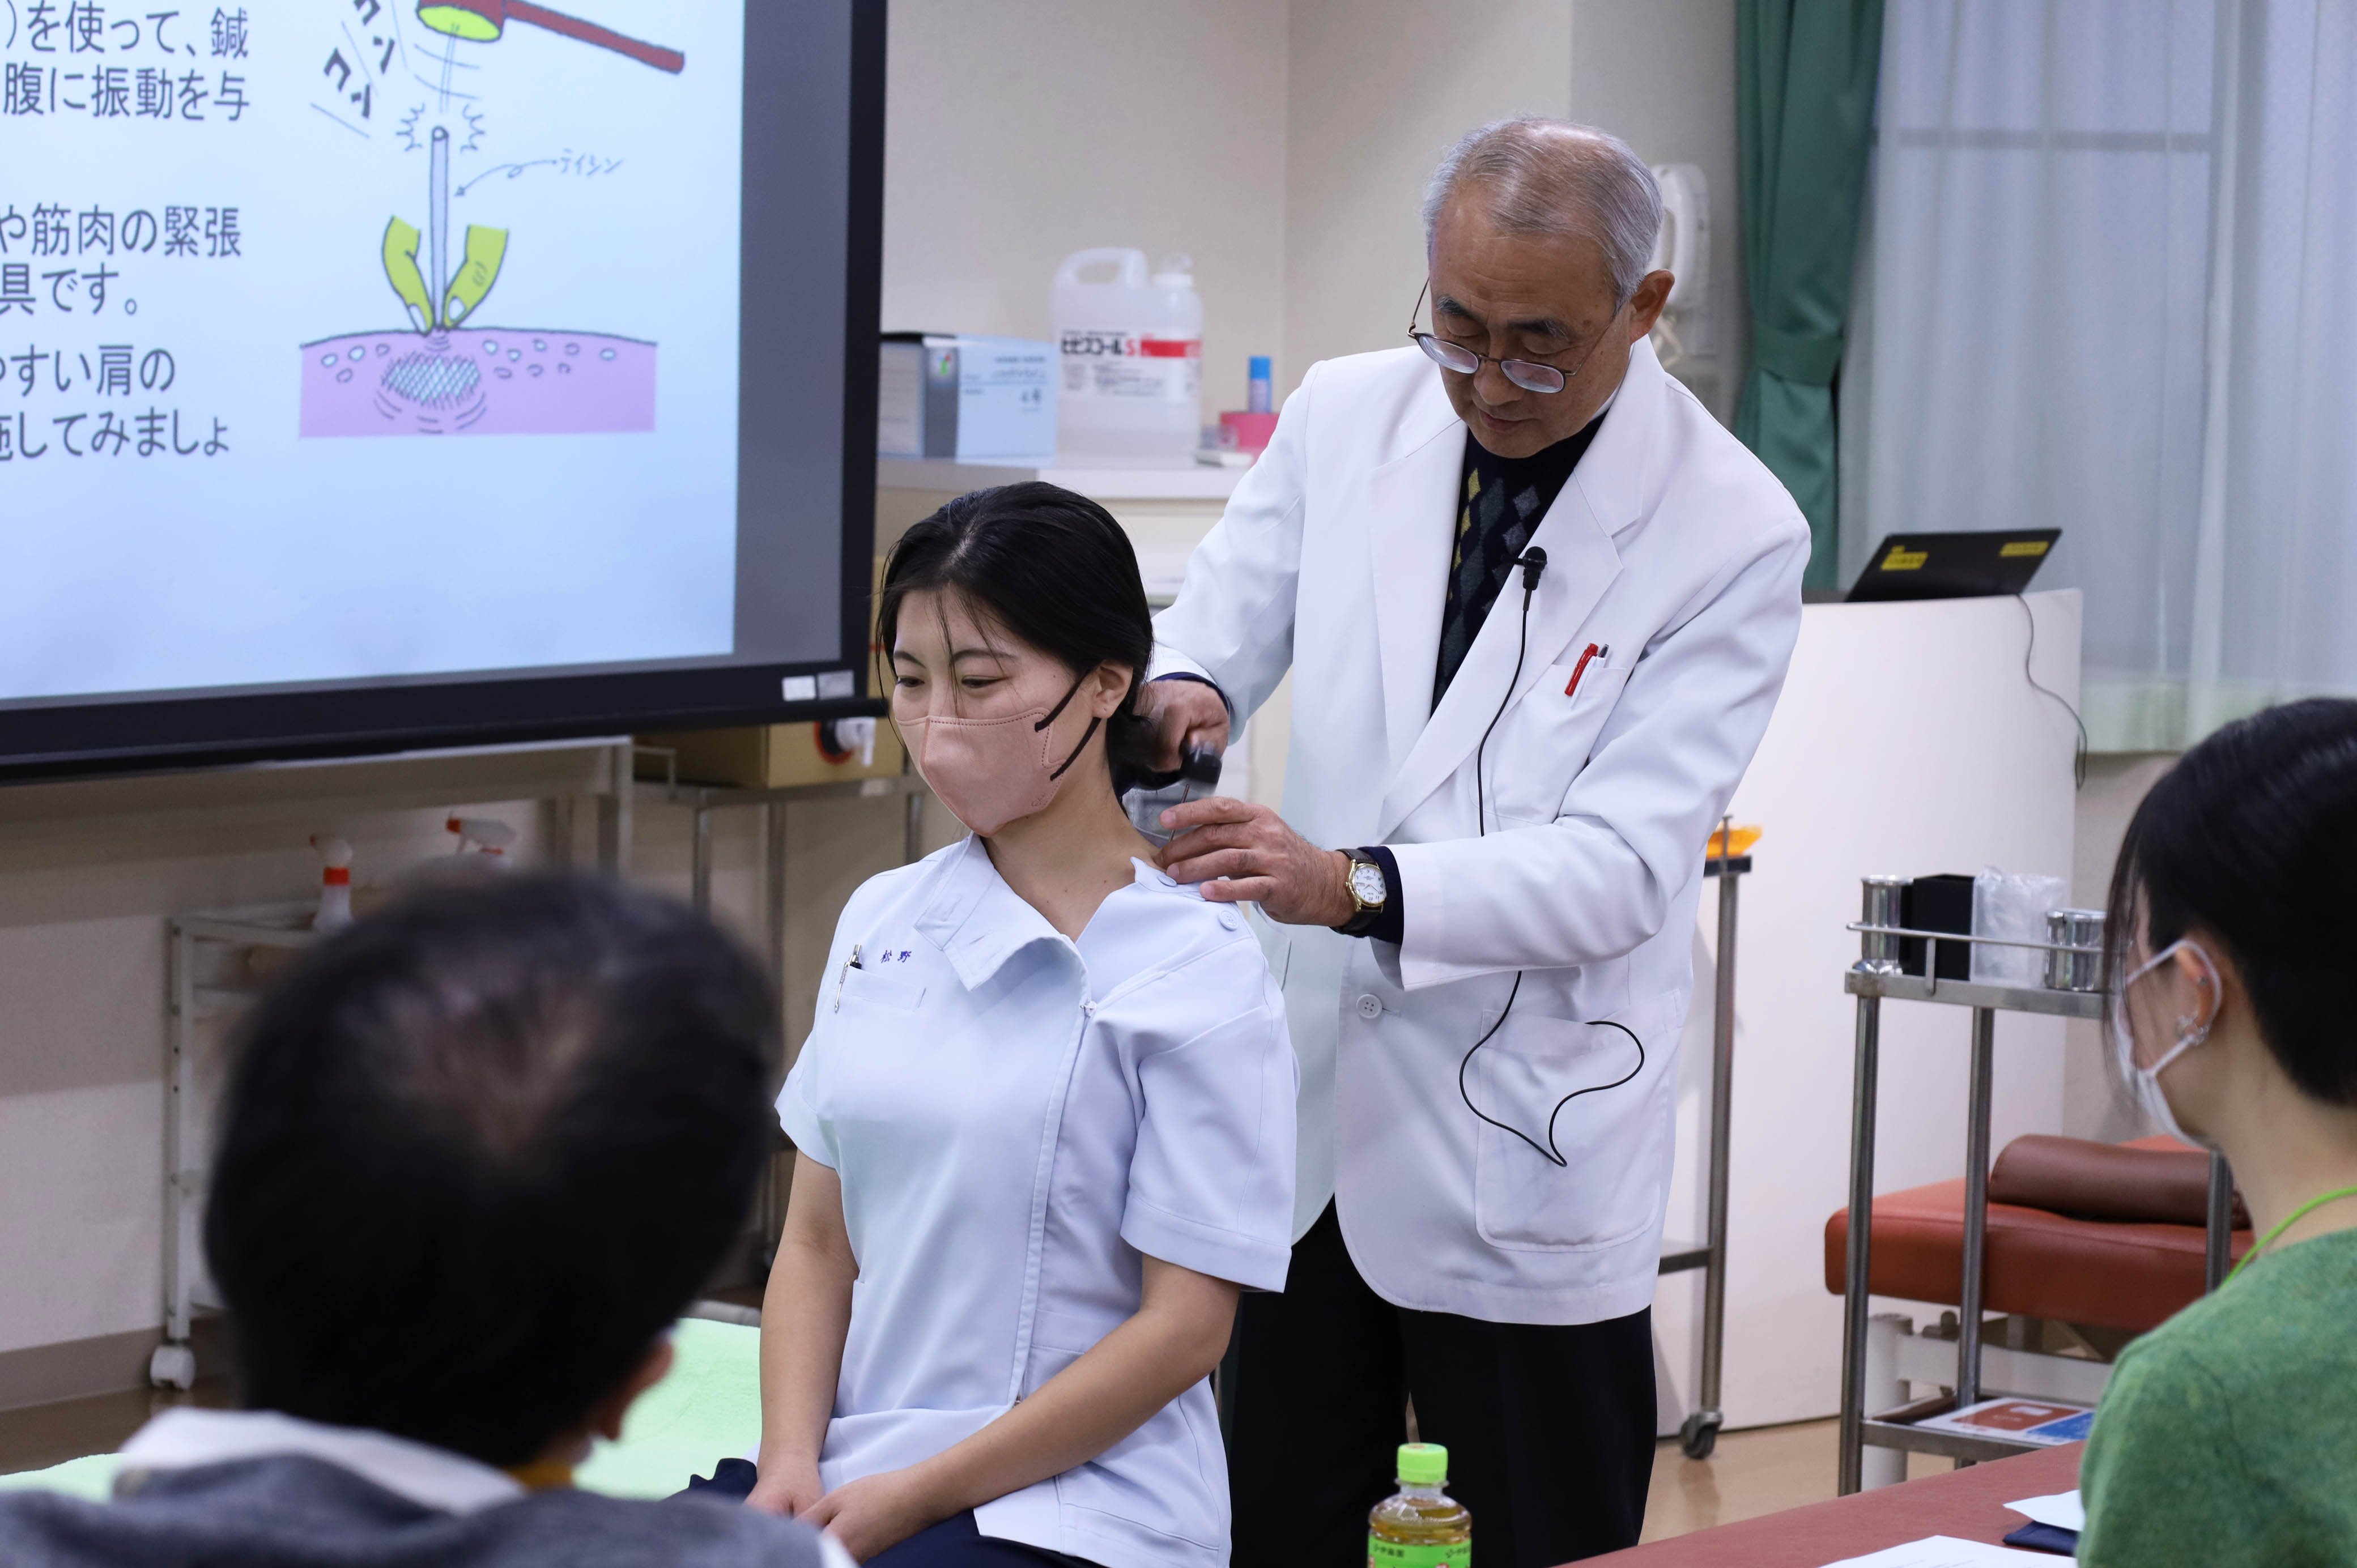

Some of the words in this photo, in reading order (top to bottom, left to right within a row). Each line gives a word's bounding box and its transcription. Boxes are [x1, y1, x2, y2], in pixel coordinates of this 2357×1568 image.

[3, 61, 249, 121] 腹に振動を与
[0, 202, 242, 258] や筋肉の緊張
[0, 263, 138, 316] 具です。
